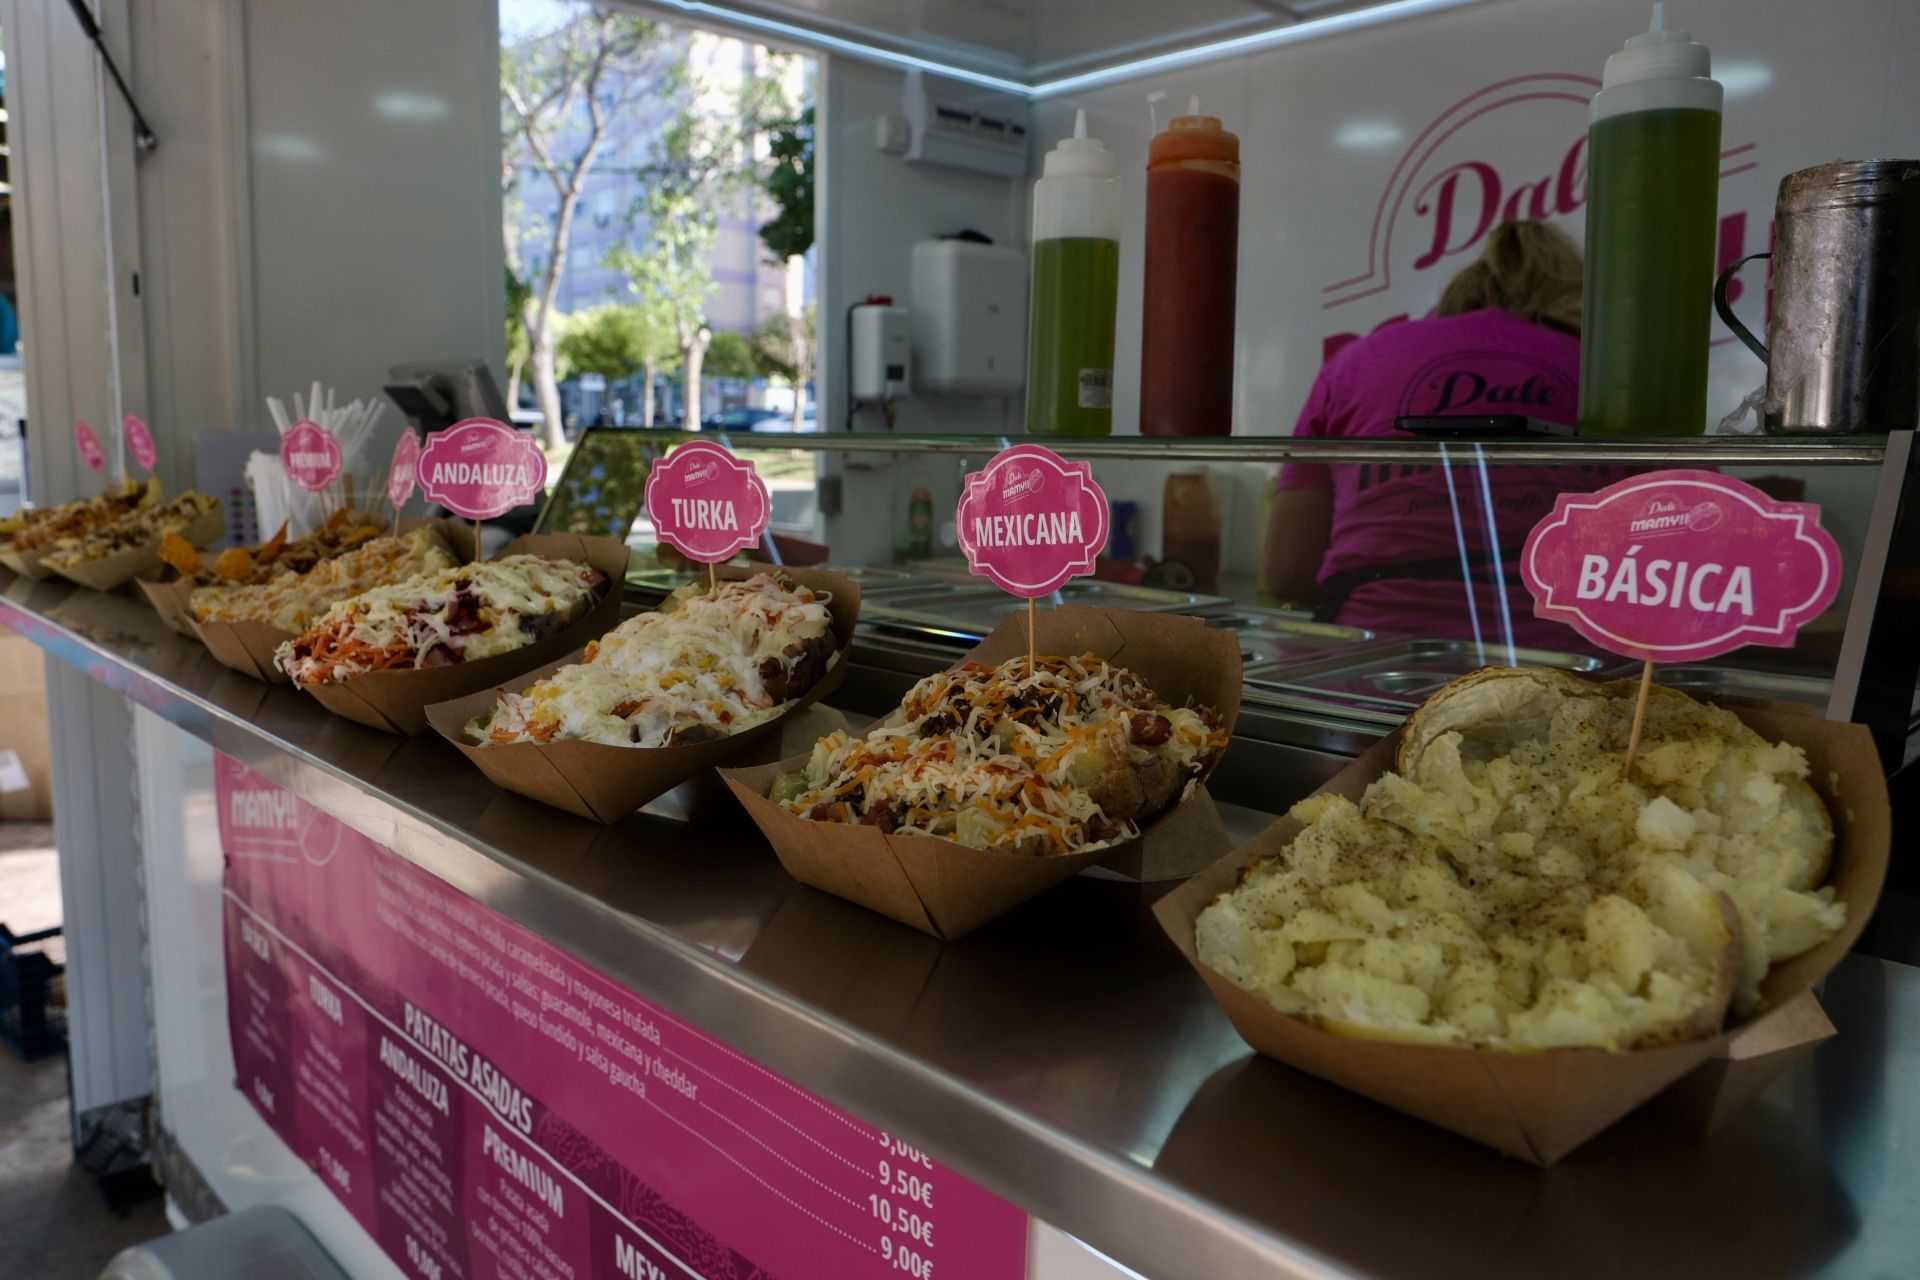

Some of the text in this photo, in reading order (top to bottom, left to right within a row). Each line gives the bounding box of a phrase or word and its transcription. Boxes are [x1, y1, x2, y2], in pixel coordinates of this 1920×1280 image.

[1413, 136, 1589, 270] Dal
[432, 462, 529, 486] ANDALUZA
[671, 498, 738, 531] TURKA
[1646, 501, 1676, 516] Dale
[975, 511, 1083, 547] MEXICANA
[1630, 512, 1688, 533] MAMY!!
[1576, 544, 1754, 616] BÁSICA
[379, 1035, 450, 1116] ANDALUZA
[404, 1002, 468, 1078] PATATAS
[470, 1054, 533, 1134] ASADAS
[507, 941, 566, 987] caramelizada
[573, 979, 622, 1021] mayonesa
[622, 1007, 661, 1046] trufada
[879, 1160, 933, 1209] 9,50€
[511, 1001, 538, 1029] queso
[538, 1012, 577, 1053] fundido
[577, 1040, 585, 1062] y
[585, 1044, 609, 1074] salsa
[609, 1063, 646, 1099] gaucha
[880, 1235, 933, 1280] 9,00€
[541, 989, 595, 1037] guacamole,
[596, 1023, 643, 1066] mexicana
[644, 1053, 652, 1076] y
[652, 1058, 698, 1101] cheddar
[869, 1194, 933, 1248] 10,50€
[483, 1123, 564, 1219] PREMIUM
